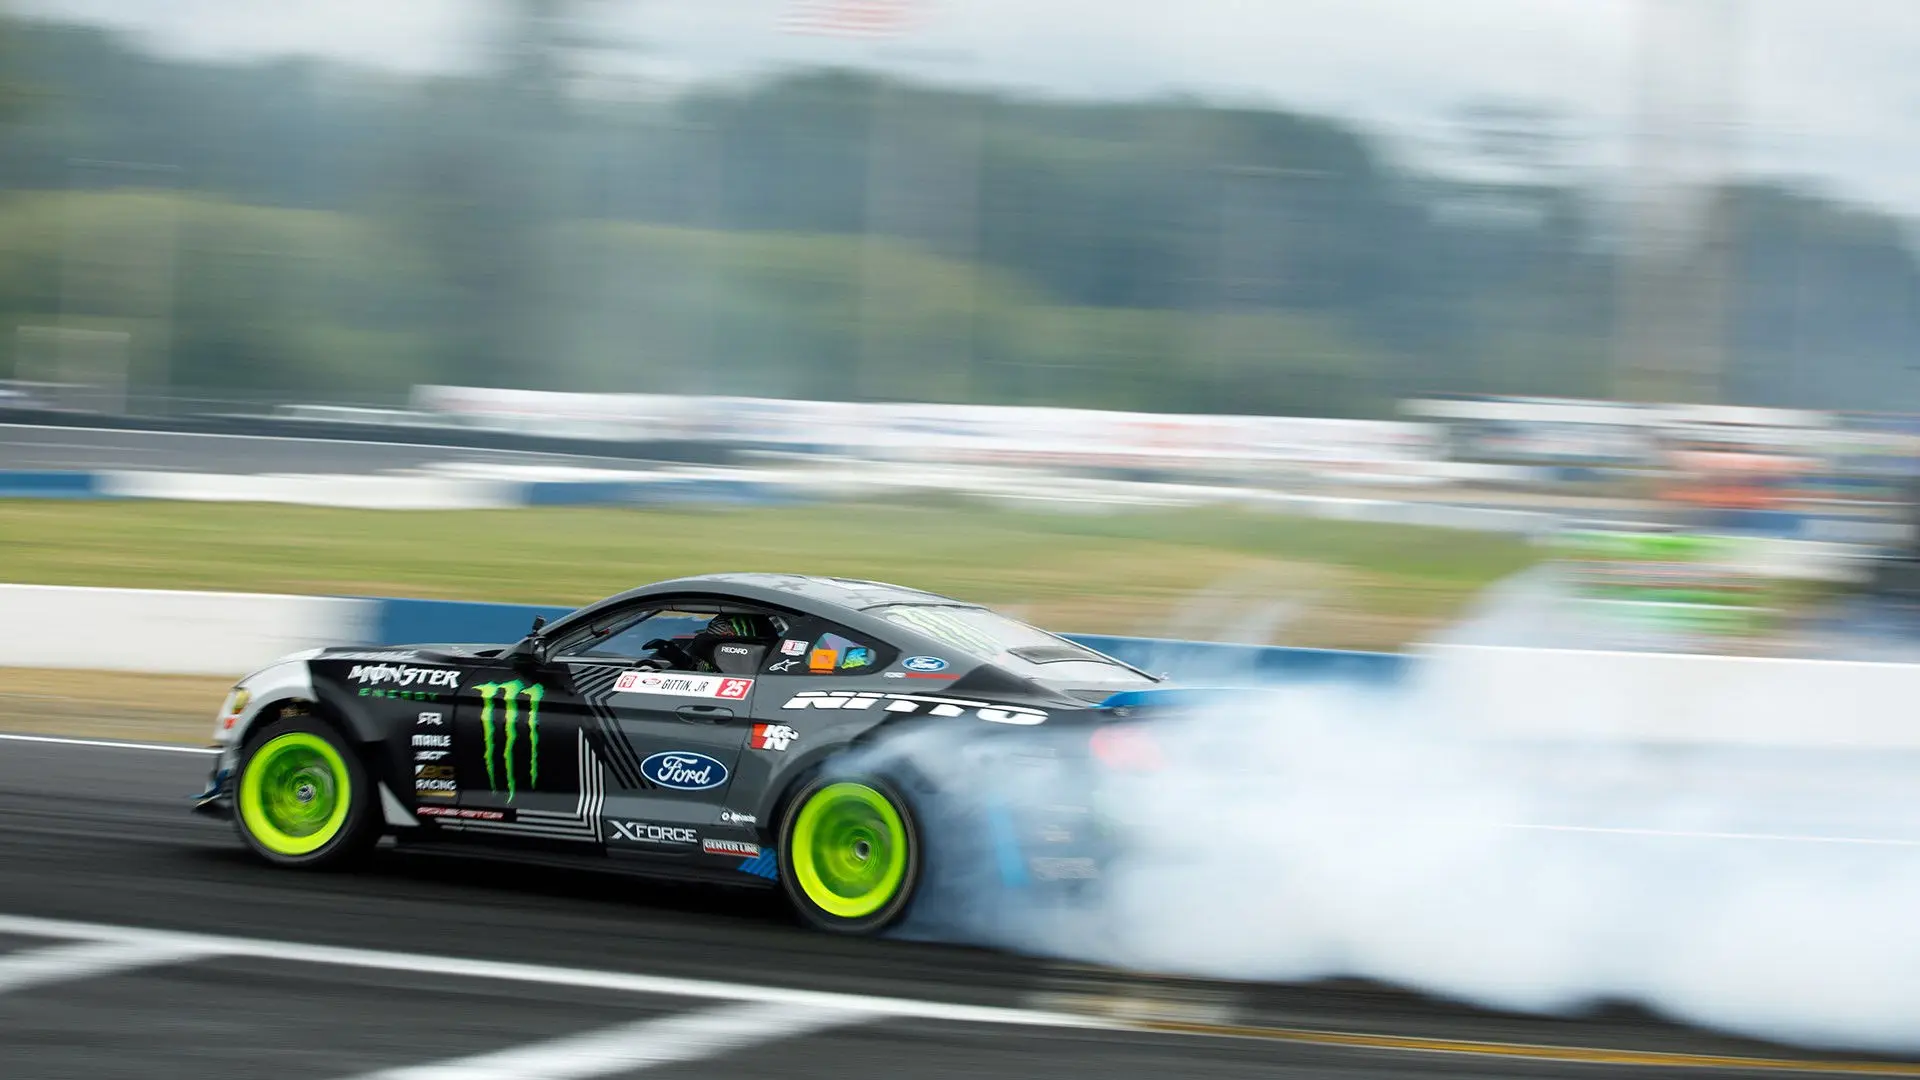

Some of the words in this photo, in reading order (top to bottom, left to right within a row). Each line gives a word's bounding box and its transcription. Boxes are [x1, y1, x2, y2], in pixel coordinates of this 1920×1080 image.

[721, 646, 748, 655] RECARO
[347, 663, 461, 688] MONSTER
[358, 687, 438, 701] ENERGY
[720, 680, 747, 697] 25
[781, 690, 1049, 726] NITTO
[411, 734, 452, 747] MAHLE
[657, 754, 711, 785] Ford
[415, 779, 457, 791] RACING
[704, 840, 740, 851] CENTER
